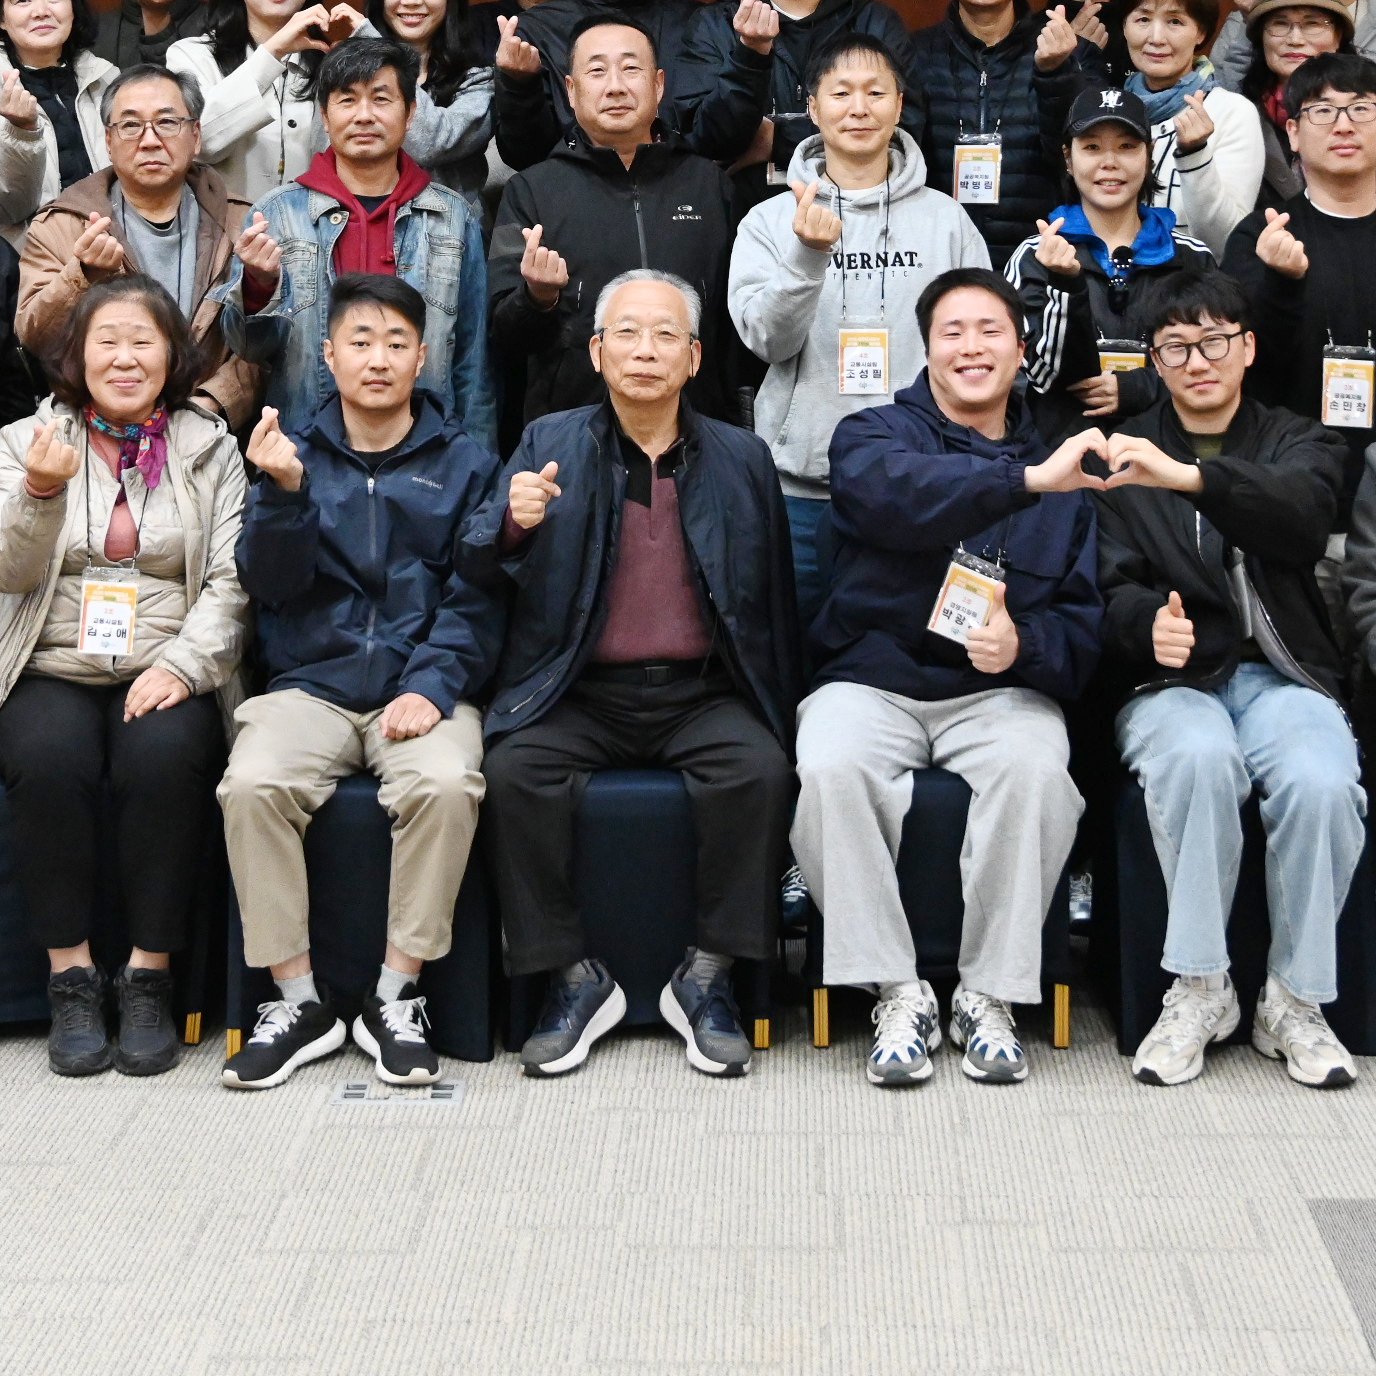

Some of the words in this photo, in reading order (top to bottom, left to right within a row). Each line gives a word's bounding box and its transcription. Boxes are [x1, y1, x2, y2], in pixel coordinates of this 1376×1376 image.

[828, 251, 918, 270] VERNAT
[846, 369, 881, 378] 조성필
[942, 607, 972, 629] 박광
